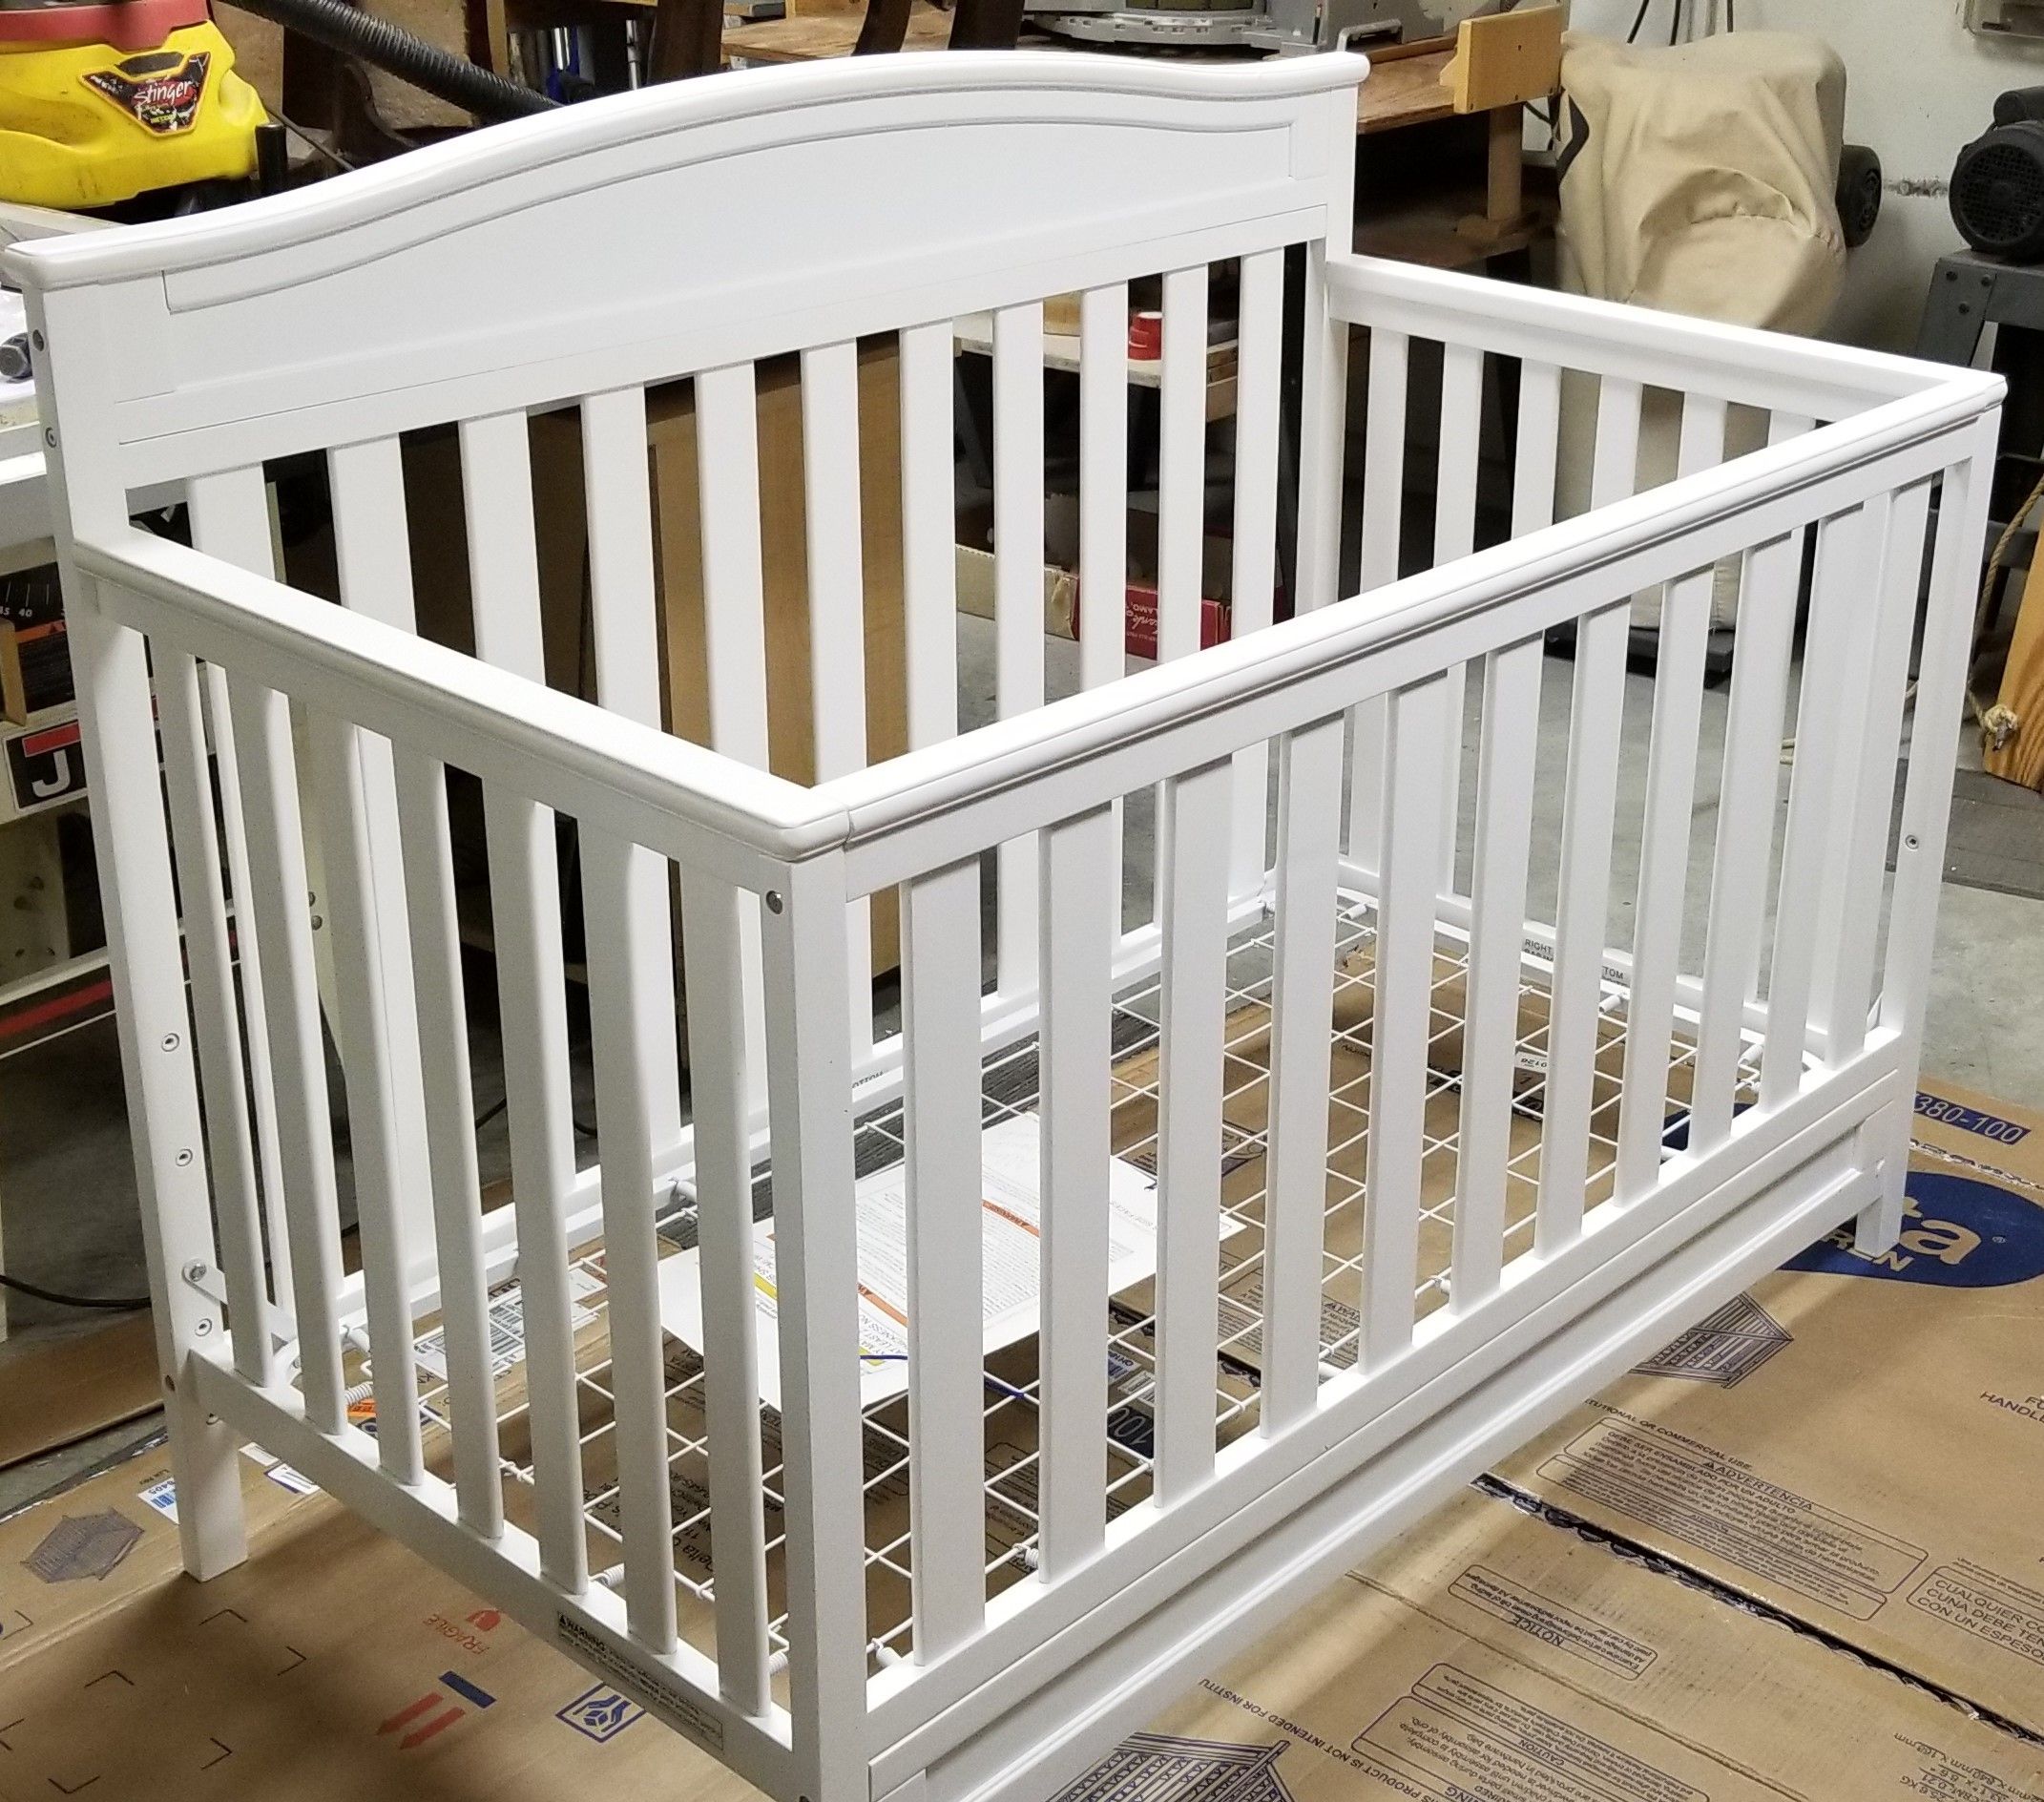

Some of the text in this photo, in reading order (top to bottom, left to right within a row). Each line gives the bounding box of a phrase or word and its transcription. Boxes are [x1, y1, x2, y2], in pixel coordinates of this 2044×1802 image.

[134, 80, 193, 105] Stinger
[18, 607, 33, 618] 40
[1524, 939, 1553, 953] RIGHT
[1638, 1419, 1658, 1429] OR
[1657, 1425, 1727, 1459] COMMERCIAL
[1714, 1464, 1815, 1510] ADVERTENCIA
[1718, 1477, 1741, 1489] POR
[1739, 1486, 1755, 1496] UN
[1754, 1494, 1797, 1514] ADULTO
[1925, 1586, 1971, 1611] CUNA
[1970, 1608, 2016, 1632] DEBE
[1933, 1579, 2025, 1623] CUALQUIER
[422, 1613, 490, 1656] FRAGILE
[1510, 1615, 1566, 1645] NOTICE
[1915, 1595, 2044, 1660] CON UN ESPESO
[1197, 1676, 1244, 1705] INSTITU
[1240, 1699, 1270, 1718] FOR
[1265, 1713, 1326, 1749] INTENDED
[1322, 1743, 1351, 1762] NOT
[1348, 1757, 1365, 1769] IS
[1447, 1747, 1491, 1773] assembly
[1483, 1744, 1527, 1769] hardware
[1517, 1739, 1566, 1766] CAUTION
[1361, 1763, 1423, 1799] PRODUCT
